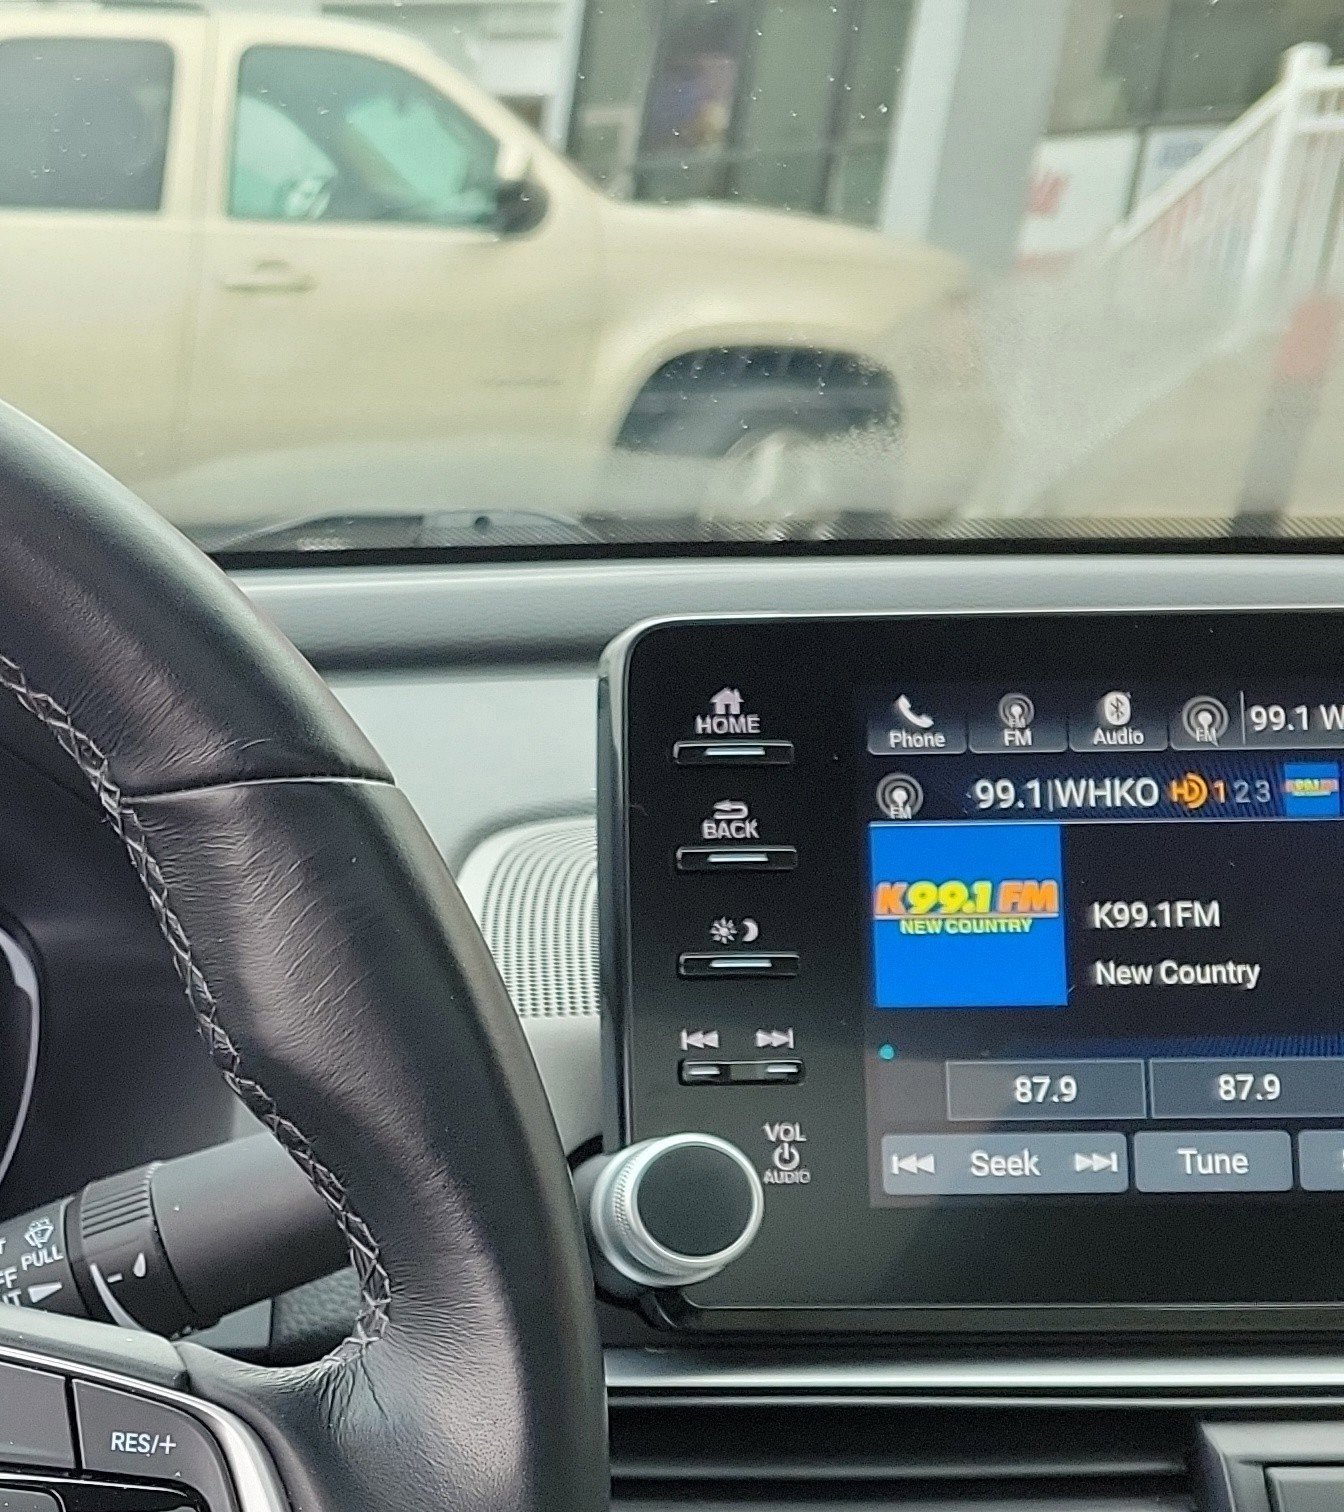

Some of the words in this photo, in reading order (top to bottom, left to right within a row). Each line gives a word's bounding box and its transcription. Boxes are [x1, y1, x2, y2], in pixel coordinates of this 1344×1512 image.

[696, 716, 760, 734] HOME
[1250, 705, 1310, 731] 99.1
[889, 730, 946, 749] Phone
[1004, 730, 1032, 746] FM
[1093, 729, 1145, 746] Audio
[1214, 781, 1226, 803] 1
[1235, 780, 1250, 803] 2
[1256, 780, 1271, 802] 3
[704, 821, 759, 841] BACK
[874, 880, 992, 914] K99.1
[998, 880, 1059, 912] FM
[900, 918, 945, 934] NEW
[946, 917, 1032, 934] COUNTRY
[1093, 901, 1221, 929] K99.1FM
[1095, 960, 1154, 985] New
[1160, 959, 1260, 990] Country
[1014, 1075, 1077, 1103] 87.9
[1218, 1073, 1281, 1101] 87.9
[764, 1123, 807, 1143] VOL
[970, 1148, 1041, 1177] Seek
[1178, 1146, 1249, 1175] Tune
[763, 1169, 811, 1186] AUDIO
[20, 1245, 64, 1272] PULL
[110, 1431, 177, 1455] RES/+
